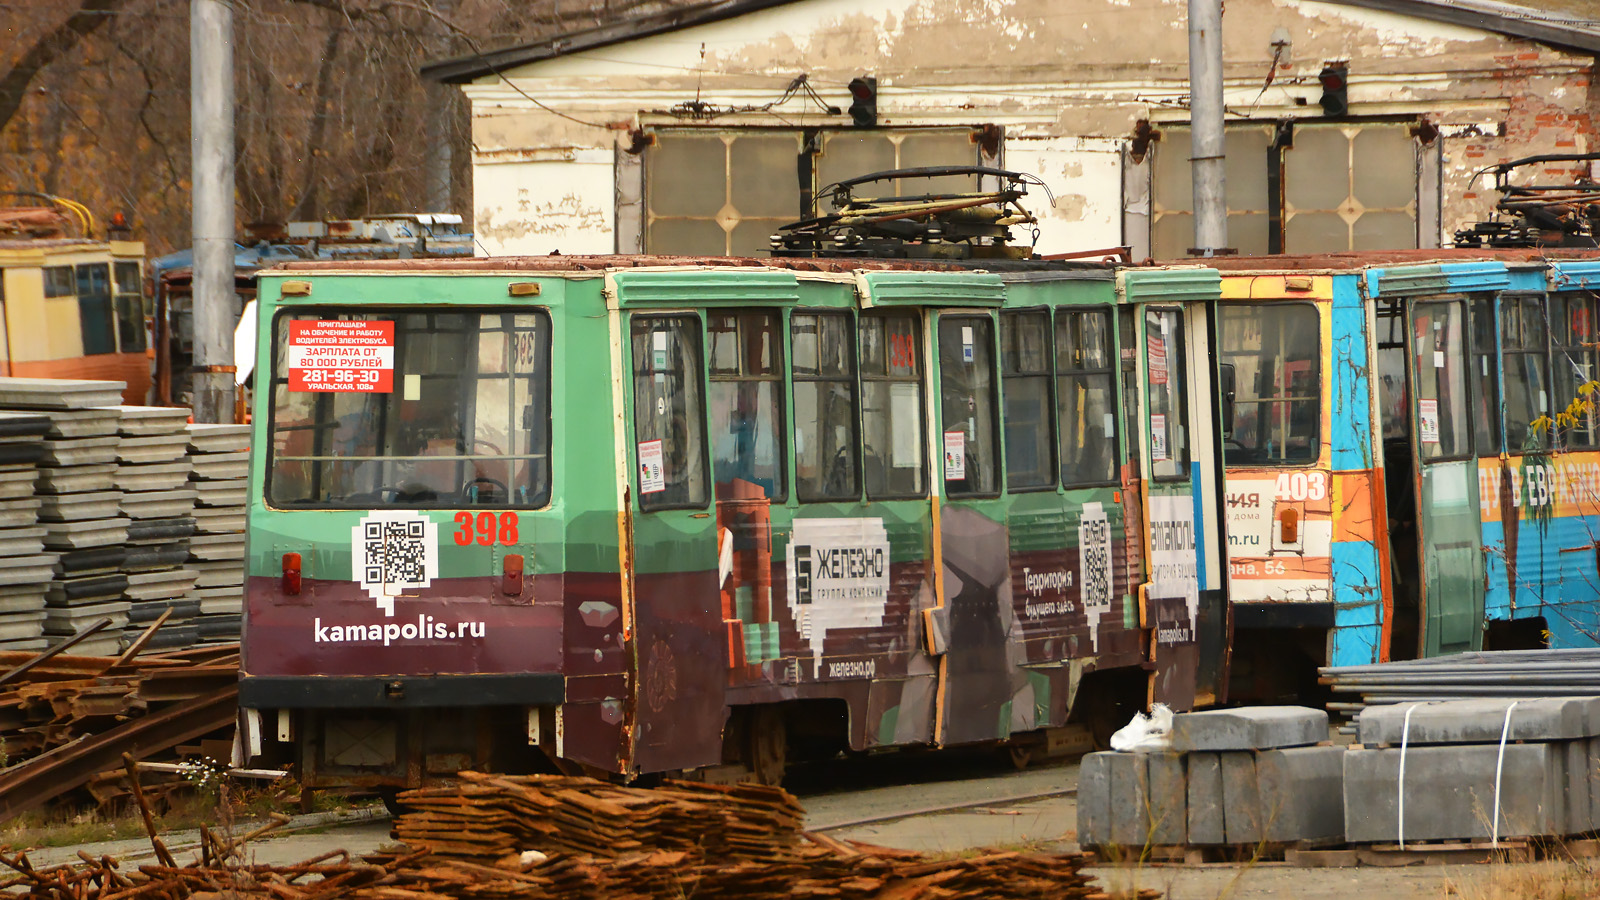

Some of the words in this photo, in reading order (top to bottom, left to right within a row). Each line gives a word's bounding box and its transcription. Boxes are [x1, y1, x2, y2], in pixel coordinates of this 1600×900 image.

[306, 348, 360, 356] ЗАРПЛАТА
[363, 348, 377, 356] ОТ
[892, 333, 913, 367] 398
[300, 359, 313, 367] 80
[316, 359, 337, 367] 000
[340, 357, 382, 367] РУБЛЕЙ
[302, 370, 379, 382] 281-96-30
[1274, 472, 1325, 501] 403
[453, 511, 519, 546] 398
[817, 548, 884, 579] ЖЕЛЕЗНО
[1264, 561, 1285, 575] 56
[818, 588, 846, 599] ГРУППА
[849, 585, 883, 599] КОМПАНИЙ
[1023, 567, 1072, 597] Территория
[1026, 598, 1055, 621] будущего
[1056, 601, 1075, 615] здесь
[314, 613, 486, 647] kamapolis.ru
[829, 658, 876, 679] железно.рф
